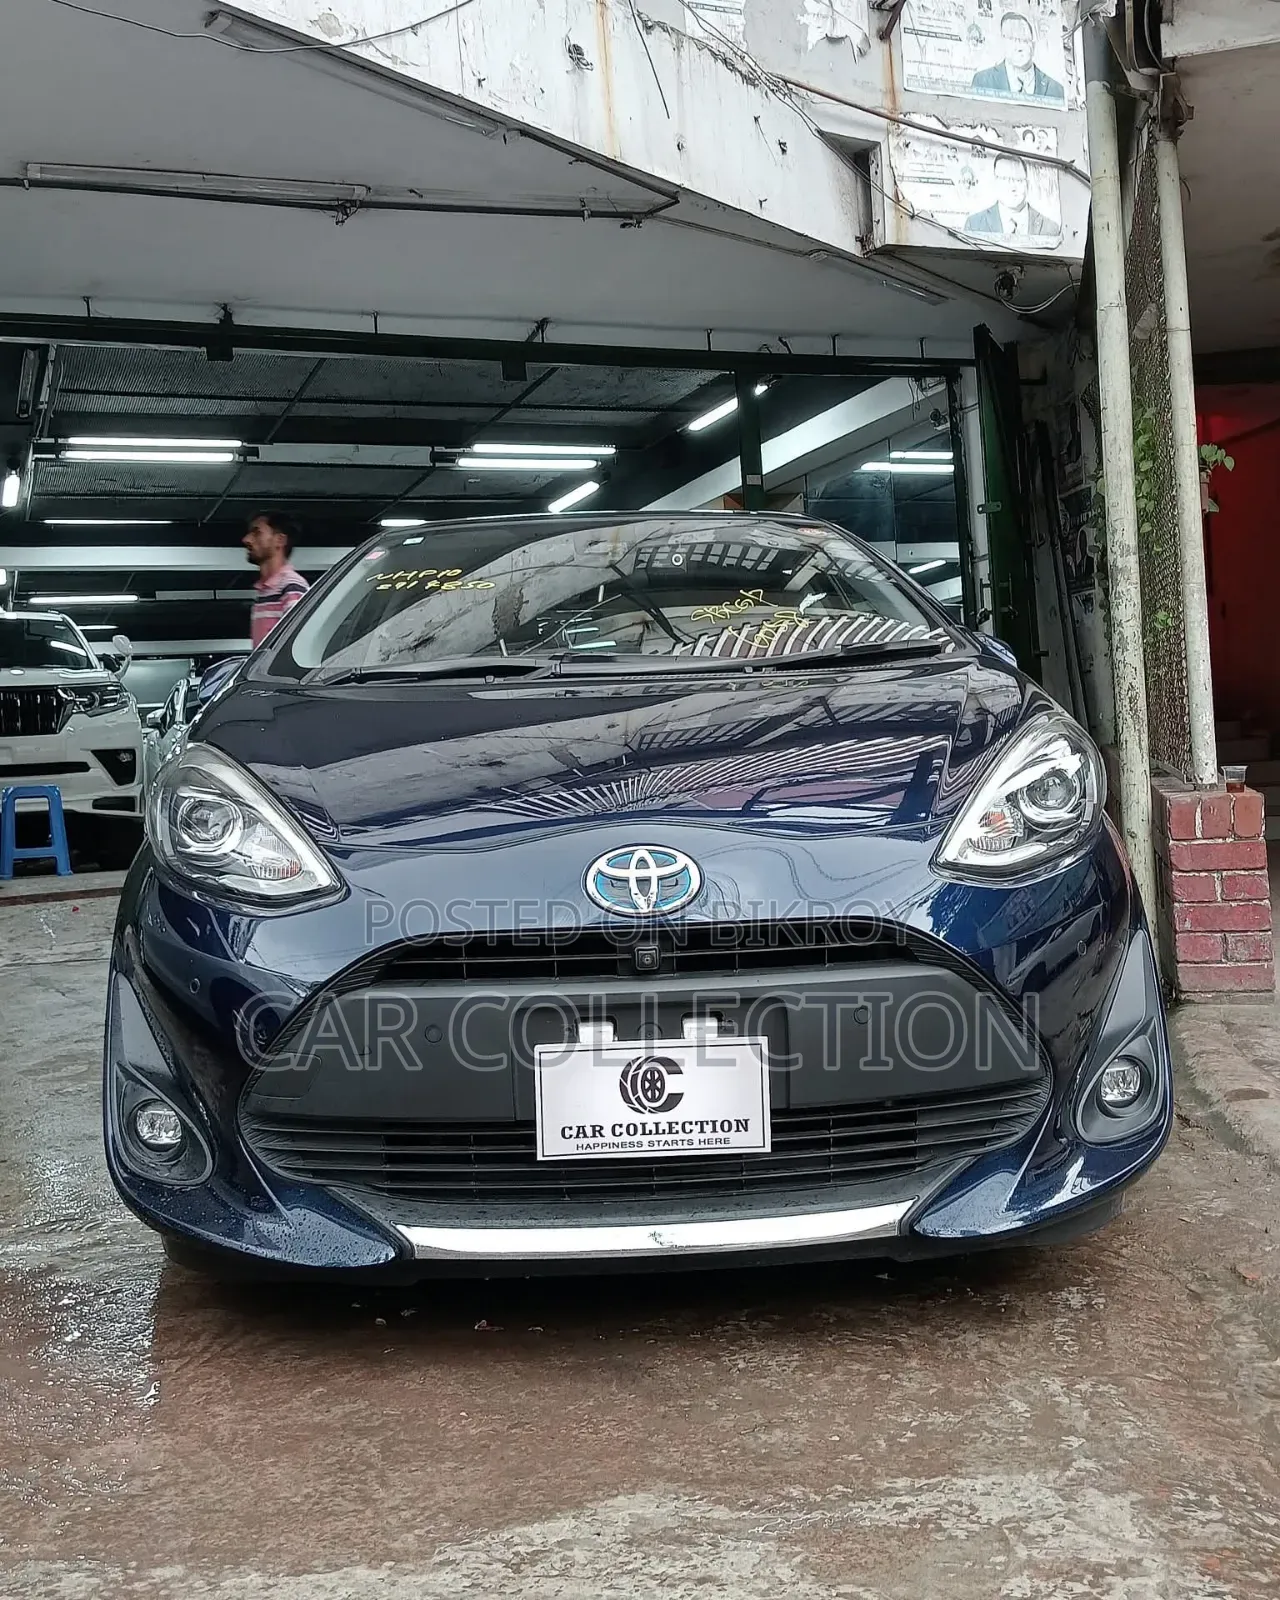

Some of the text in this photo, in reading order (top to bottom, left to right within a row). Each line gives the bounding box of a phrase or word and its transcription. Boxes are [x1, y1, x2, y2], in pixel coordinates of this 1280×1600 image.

[560, 1118, 751, 1140] CAR COLLECTION
[576, 1137, 732, 1151] HAPPINESS STARTS HERE
